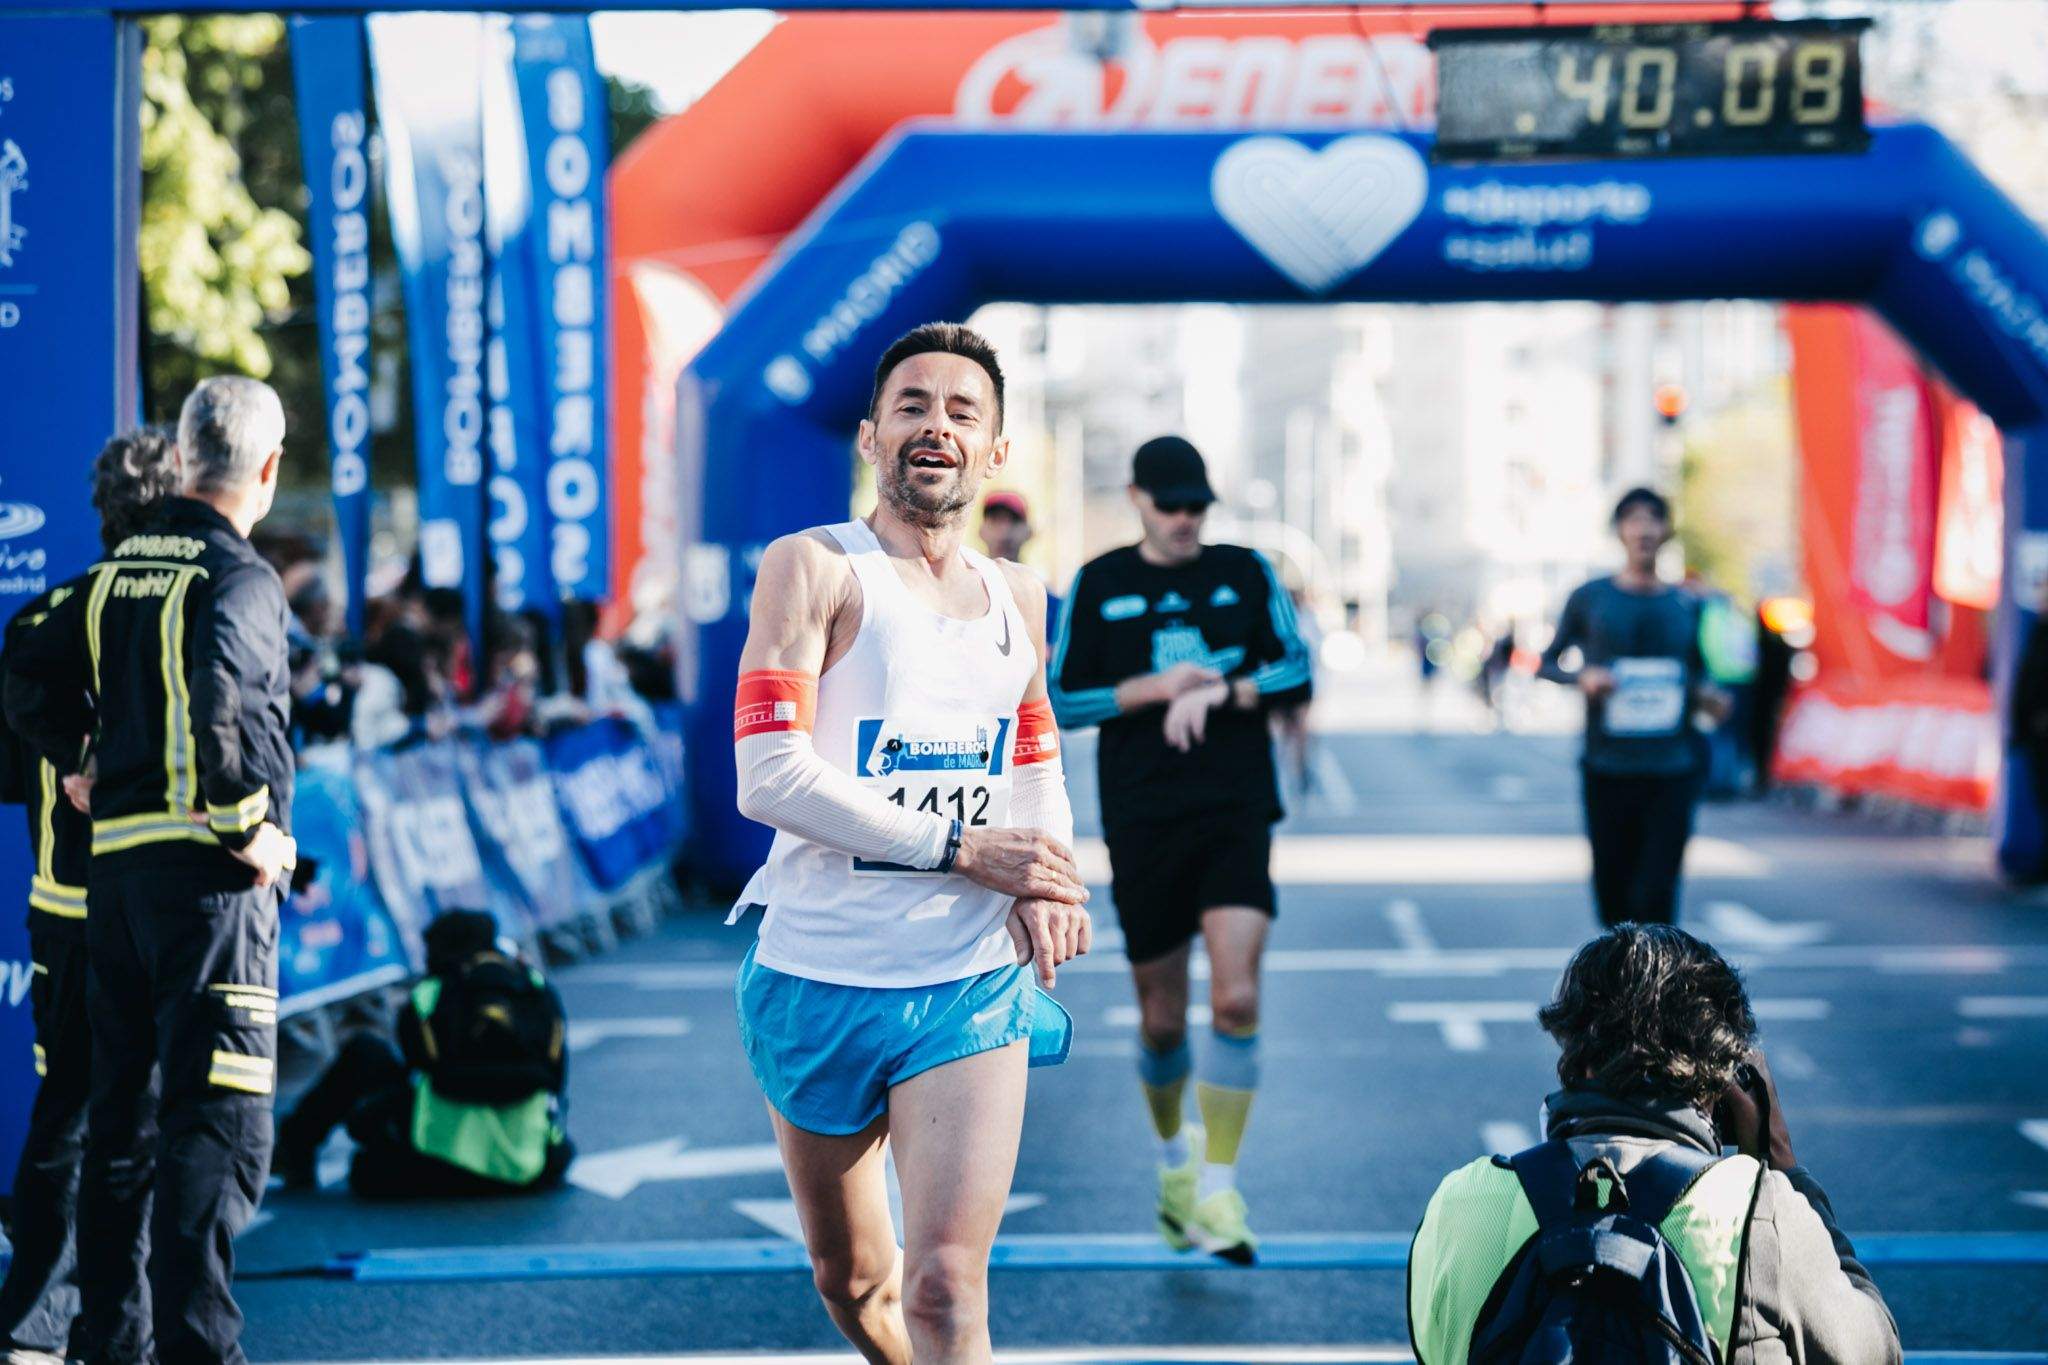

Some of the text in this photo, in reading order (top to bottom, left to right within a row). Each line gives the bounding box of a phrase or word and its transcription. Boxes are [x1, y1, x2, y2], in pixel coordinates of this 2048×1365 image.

[909, 741, 987, 756] BOMBEROS
[944, 757, 956, 768] de
[887, 785, 990, 826] 1412
